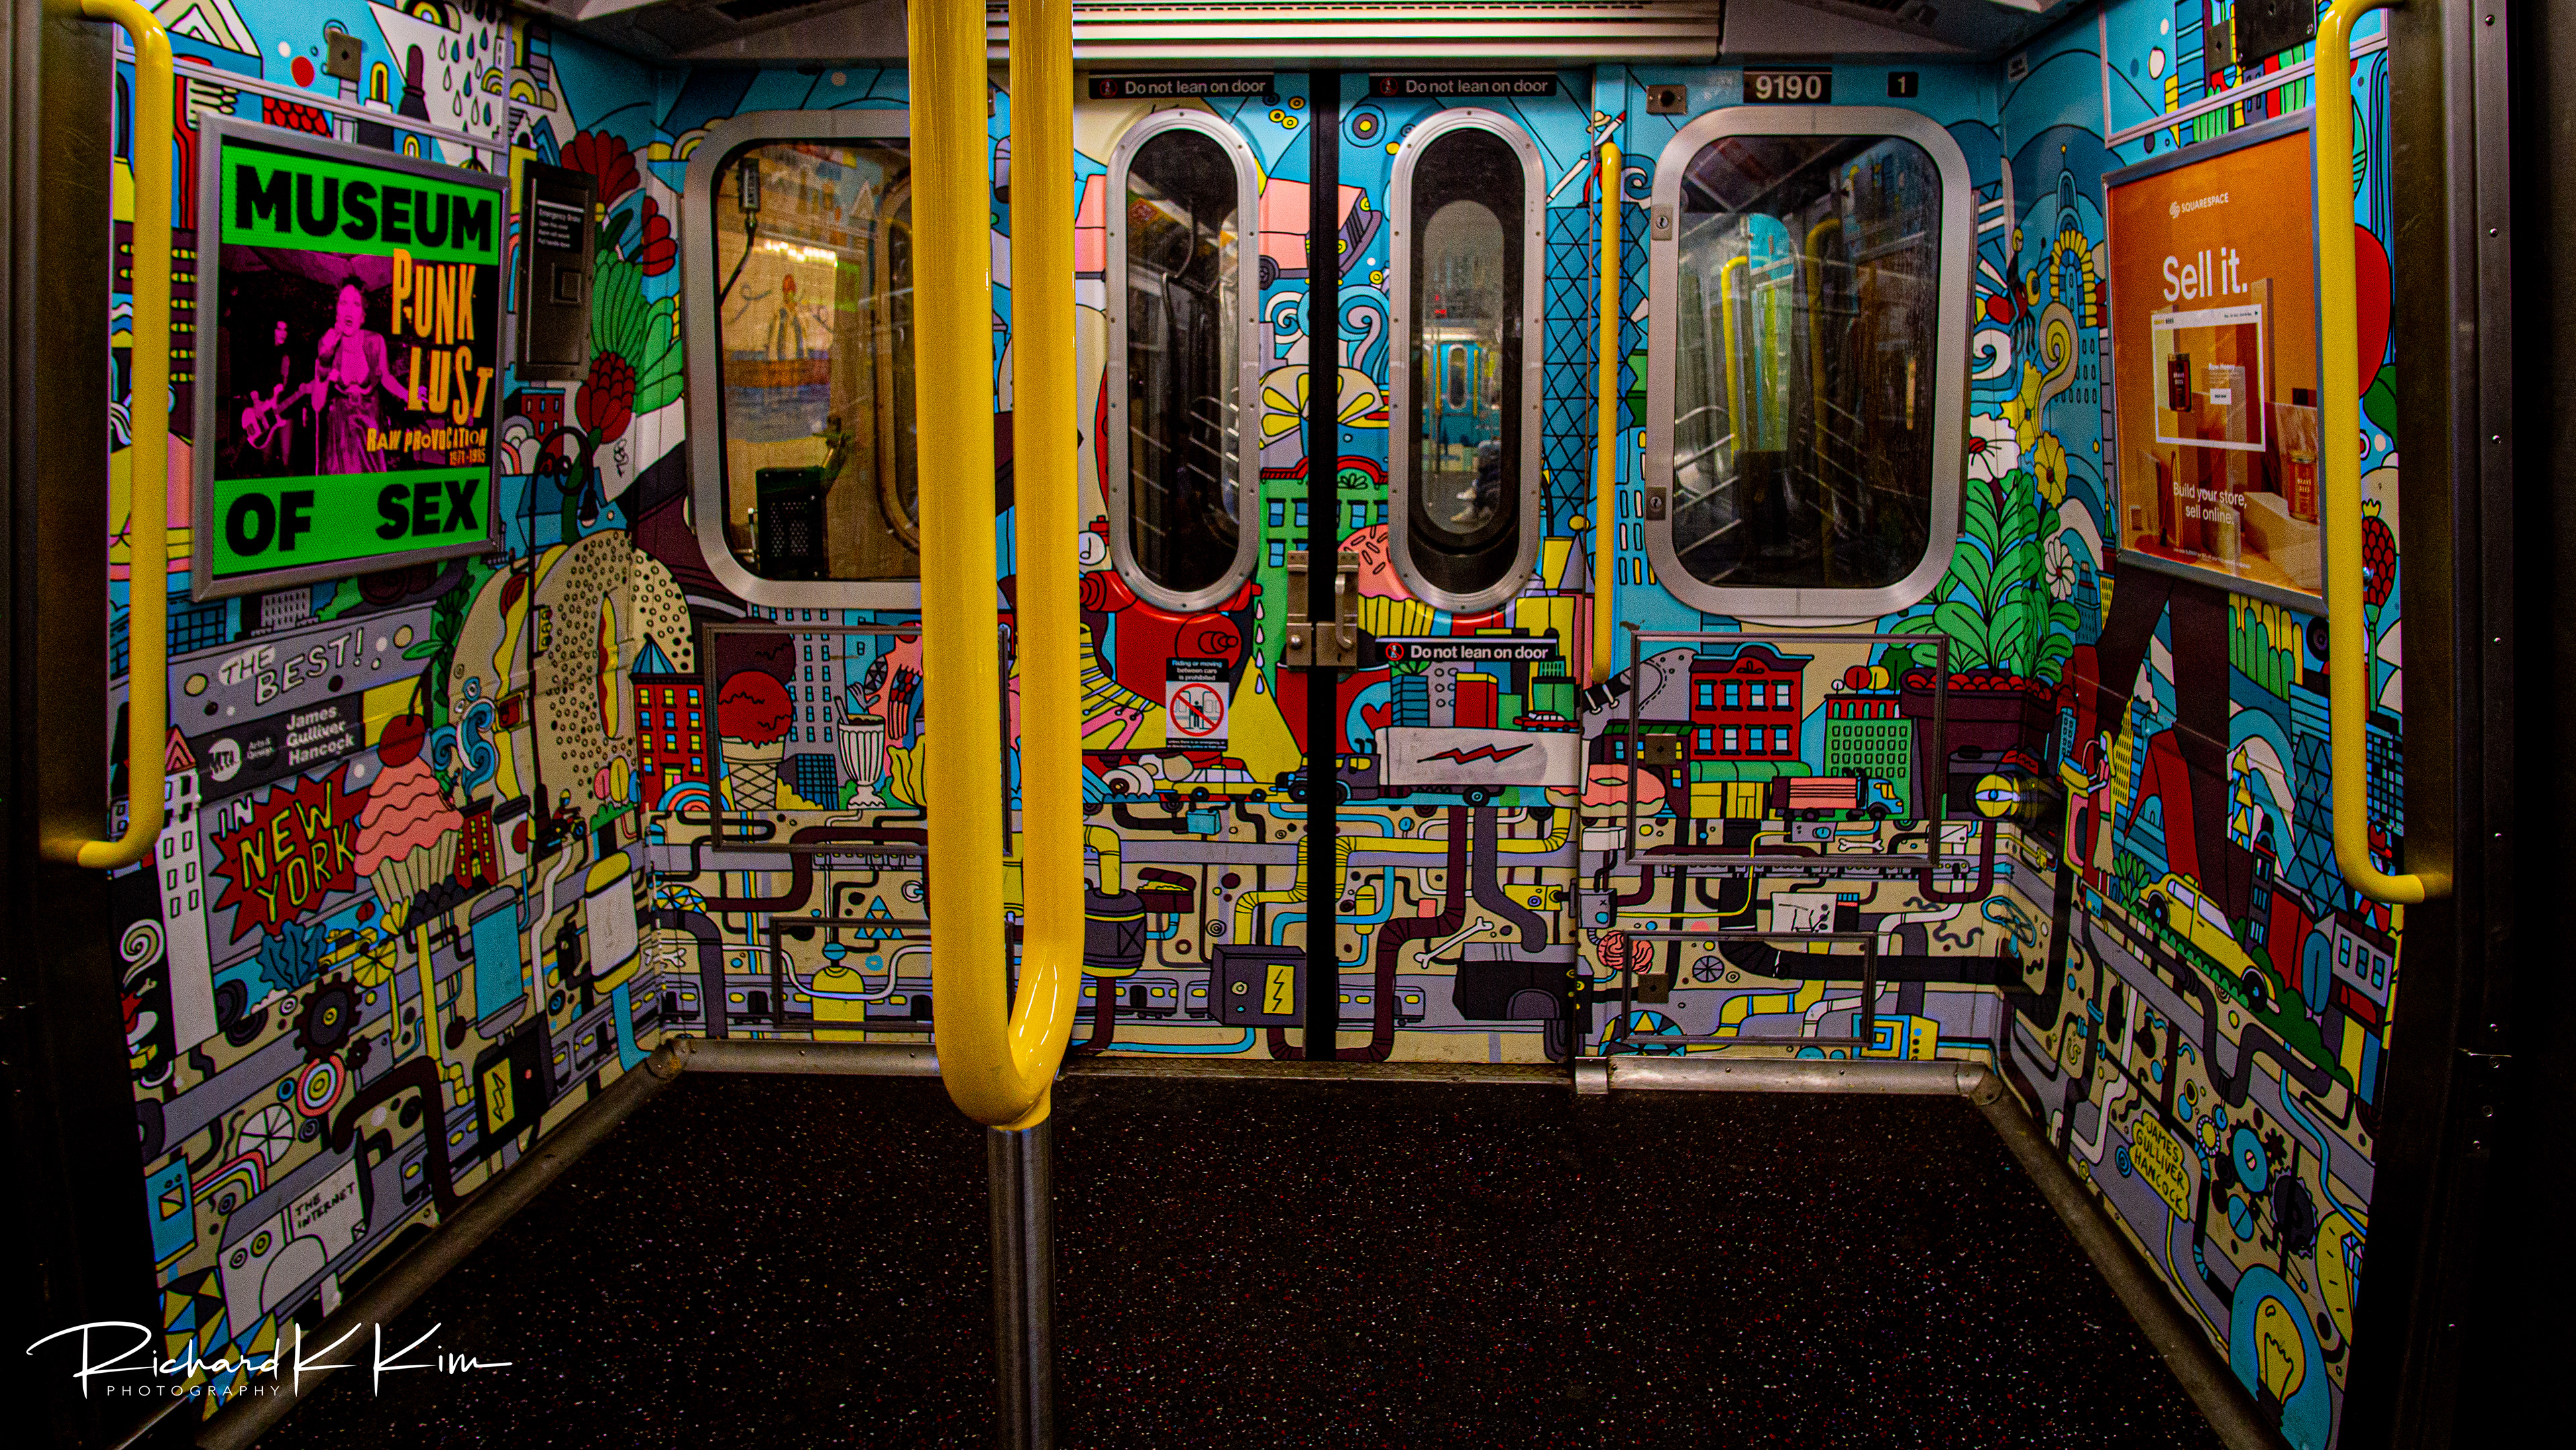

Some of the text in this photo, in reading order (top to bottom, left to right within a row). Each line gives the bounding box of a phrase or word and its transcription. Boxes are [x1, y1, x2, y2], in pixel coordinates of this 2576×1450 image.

[1125, 79, 1267, 95] Do not lean on door
[1406, 79, 1548, 93] Do not lean on door
[1756, 75, 1822, 100] 9190
[1897, 76, 1906, 94] 1
[235, 163, 492, 252] MUSEUM
[2182, 192, 2229, 213] SQUARESPACE
[2163, 246, 2248, 302] Sell it.
[391, 248, 476, 345] PUNK
[407, 346, 494, 425] LUST
[367, 427, 402, 452] RAW
[2174, 482, 2247, 509] Build your store,
[225, 479, 480, 556] OF SEX
[2186, 504, 2235, 525] sell online.
[221, 645, 273, 684] THE
[254, 627, 364, 706] BEST!
[1172, 660, 1191, 668] Riding
[1411, 645, 1548, 659] Do not lean on door
[286, 706, 337, 731] James
[286, 721, 346, 748] Gulliver
[288, 733, 354, 766] Hancock
[219, 794, 254, 839] IN
[239, 781, 333, 889] NEW
[256, 820, 356, 923] YORK
[2136, 1129, 2185, 1191] GULLIVER
[2147, 1121, 2179, 1163] JAMES
[2134, 1147, 2183, 1213] HANCOCK
[295, 1192, 321, 1216] THE
[297, 1182, 355, 1229] INTERNET
